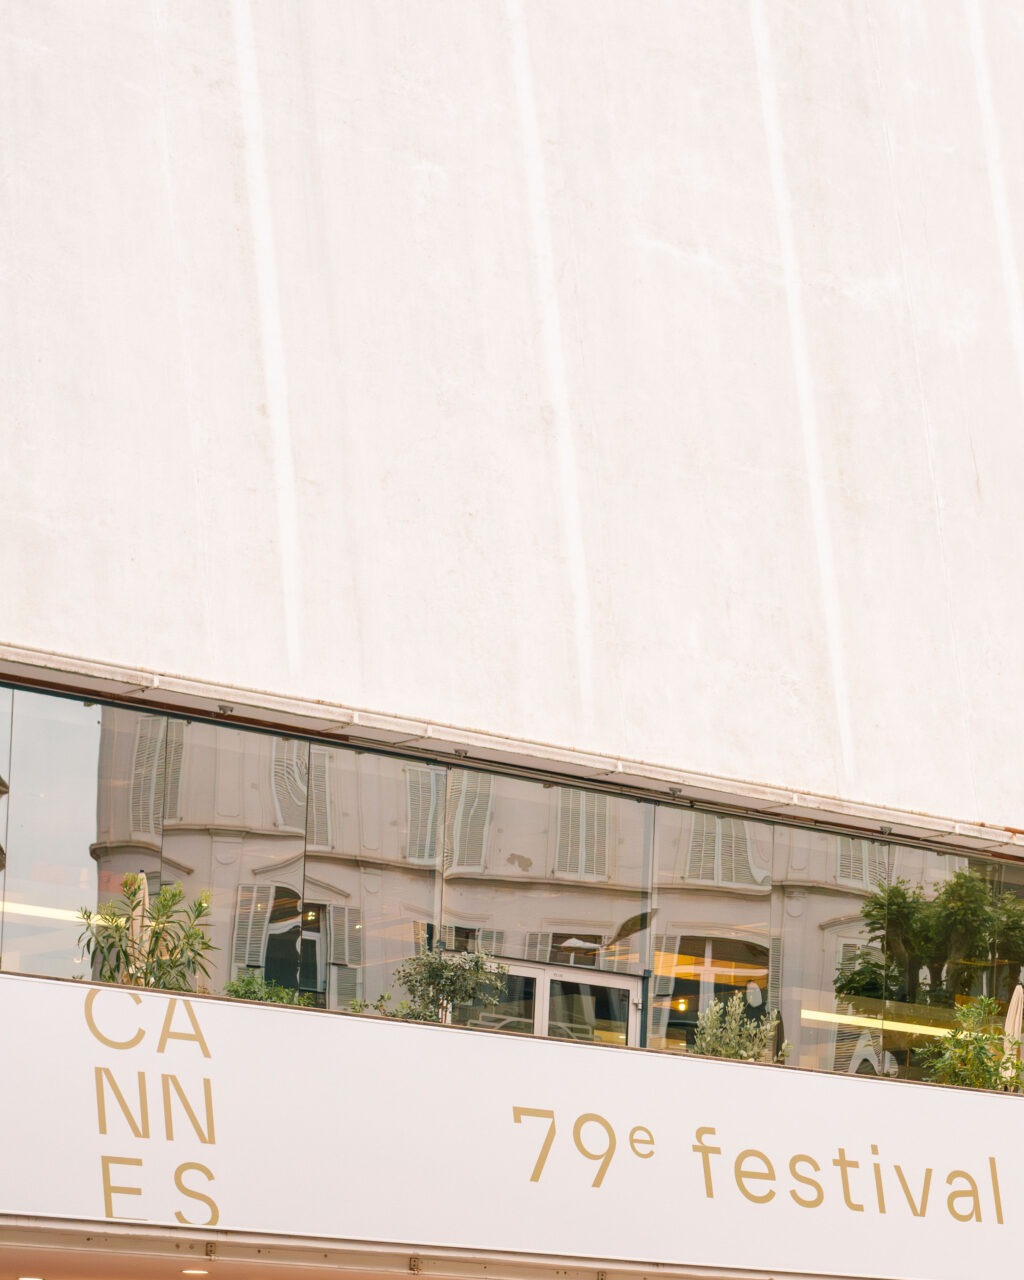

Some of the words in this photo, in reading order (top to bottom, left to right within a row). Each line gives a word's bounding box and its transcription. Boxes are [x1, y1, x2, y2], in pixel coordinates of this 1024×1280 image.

[84, 987, 212, 1059] CA
[94, 1066, 216, 1145] NN
[101, 1155, 220, 1227] ES
[512, 1105, 655, 1188] 79e
[692, 1126, 1004, 1225] festival
